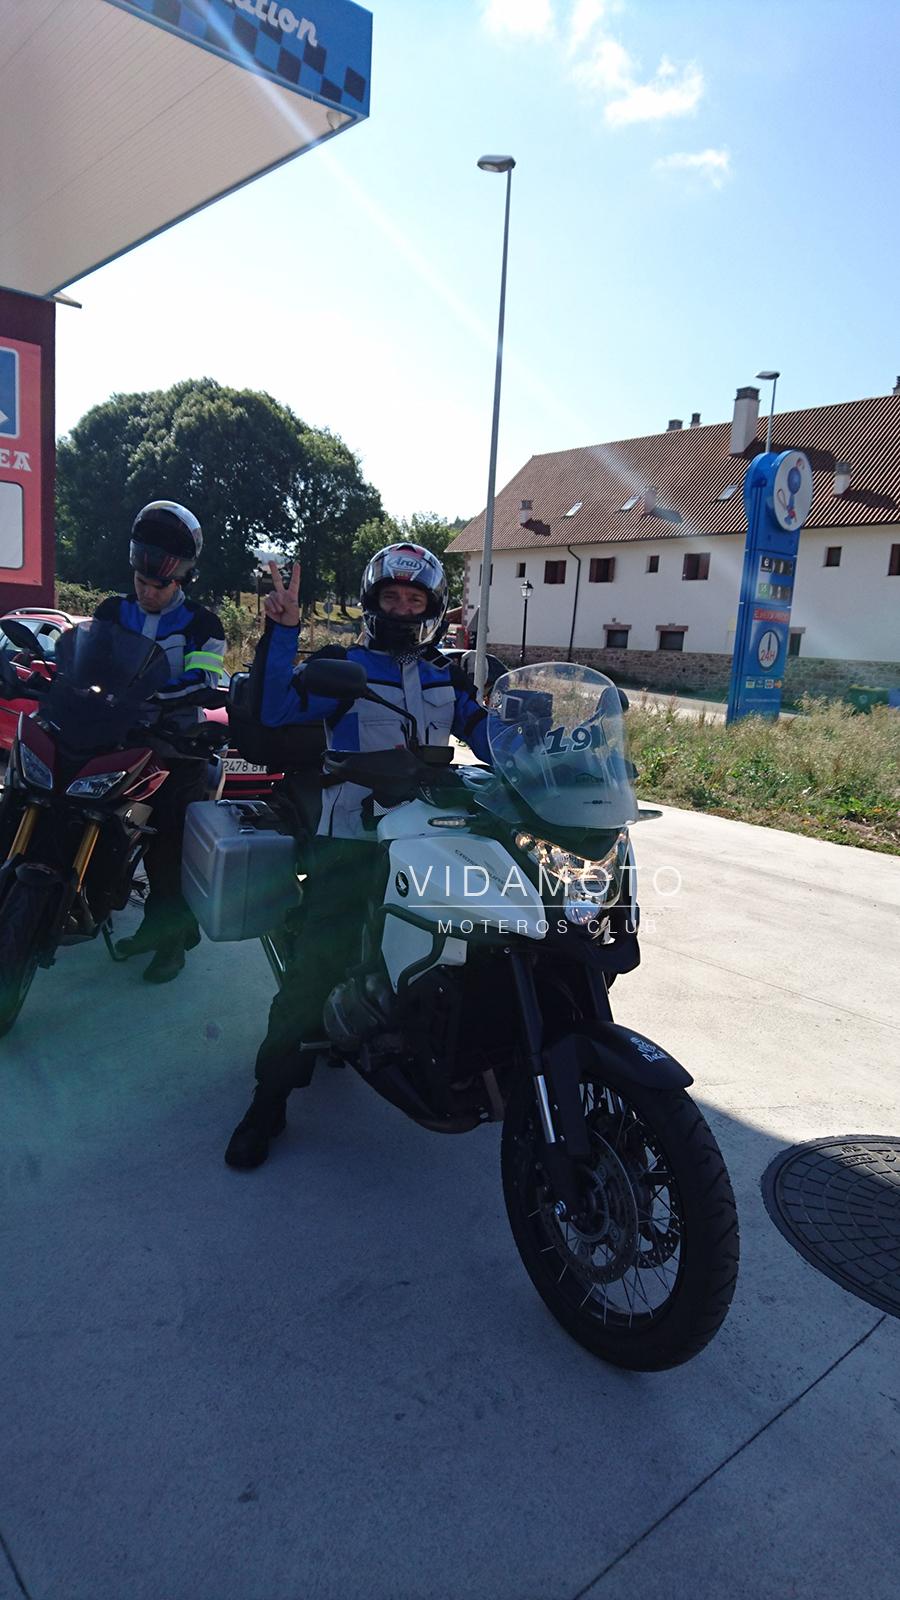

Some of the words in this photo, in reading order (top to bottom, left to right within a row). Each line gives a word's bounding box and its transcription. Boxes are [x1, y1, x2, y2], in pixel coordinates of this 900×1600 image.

[393, 556, 418, 568] Arai
[542, 726, 592, 754] 19
[223, 760, 248, 772] 2478
